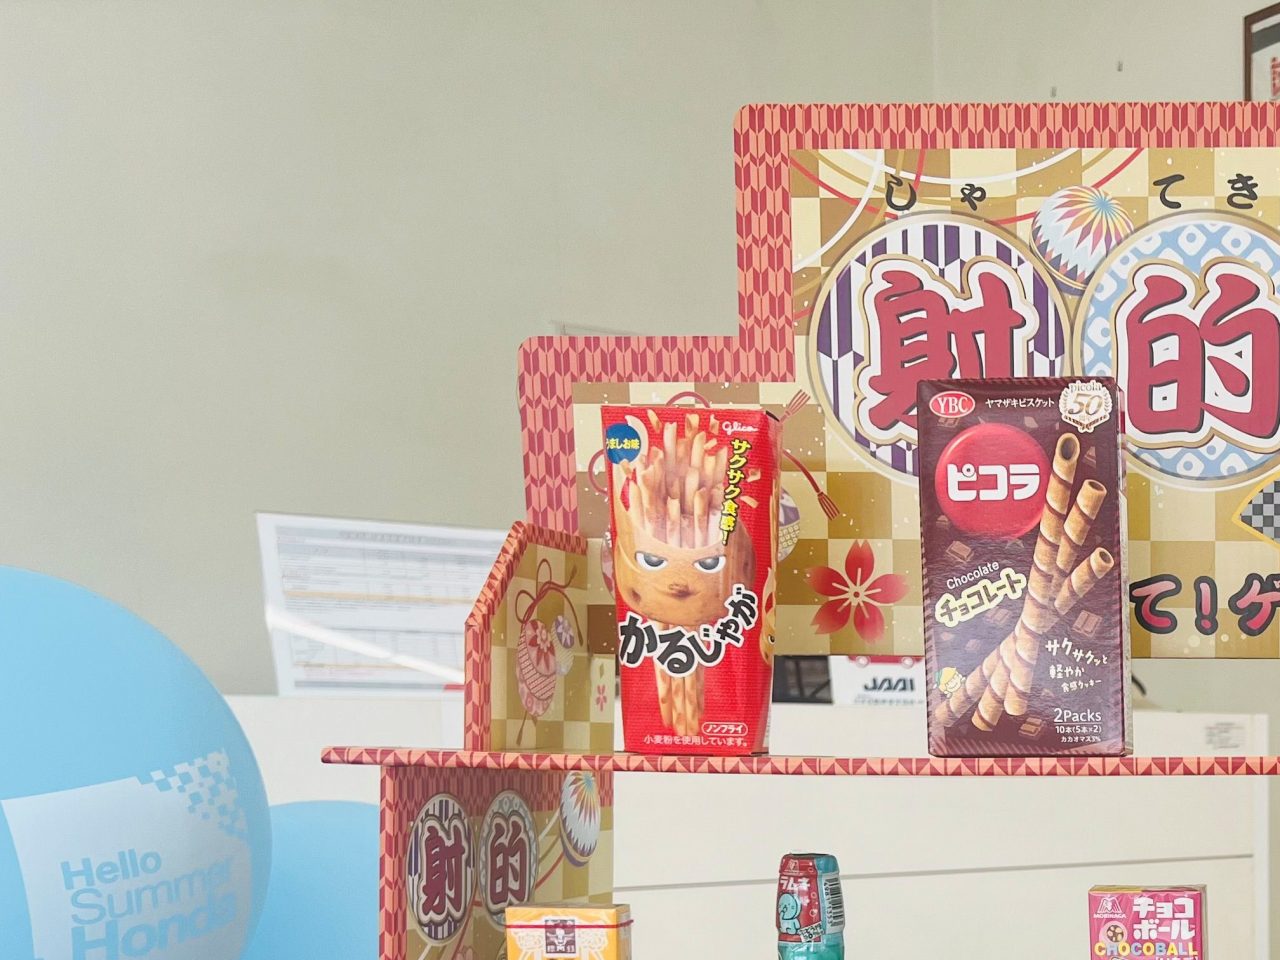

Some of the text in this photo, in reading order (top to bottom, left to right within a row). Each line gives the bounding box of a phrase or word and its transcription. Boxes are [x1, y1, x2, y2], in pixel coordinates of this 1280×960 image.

[1070, 381, 1101, 393] picola
[937, 396, 969, 413] YBC
[985, 398, 1055, 409] ヤマザキビスケット
[1068, 394, 1103, 415] 50
[947, 463, 1040, 501] ピコラ
[946, 561, 1000, 590] Chocolate
[939, 573, 1022, 622] チョコレート
[620, 586, 757, 674] かるじゃが
[1045, 637, 1108, 667] サクサクッと
[1050, 665, 1085, 679] 軽やか
[706, 724, 743, 734] ノンフライ
[644, 734, 748, 748] 小麦粉を使用しています。
[61, 849, 162, 890] Hello
[780, 876, 811, 891] ラムネ
[1132, 896, 1195, 918] チョコ
[1132, 919, 1195, 940] ボール
[1094, 942, 1198, 956] CHOCOBALL
